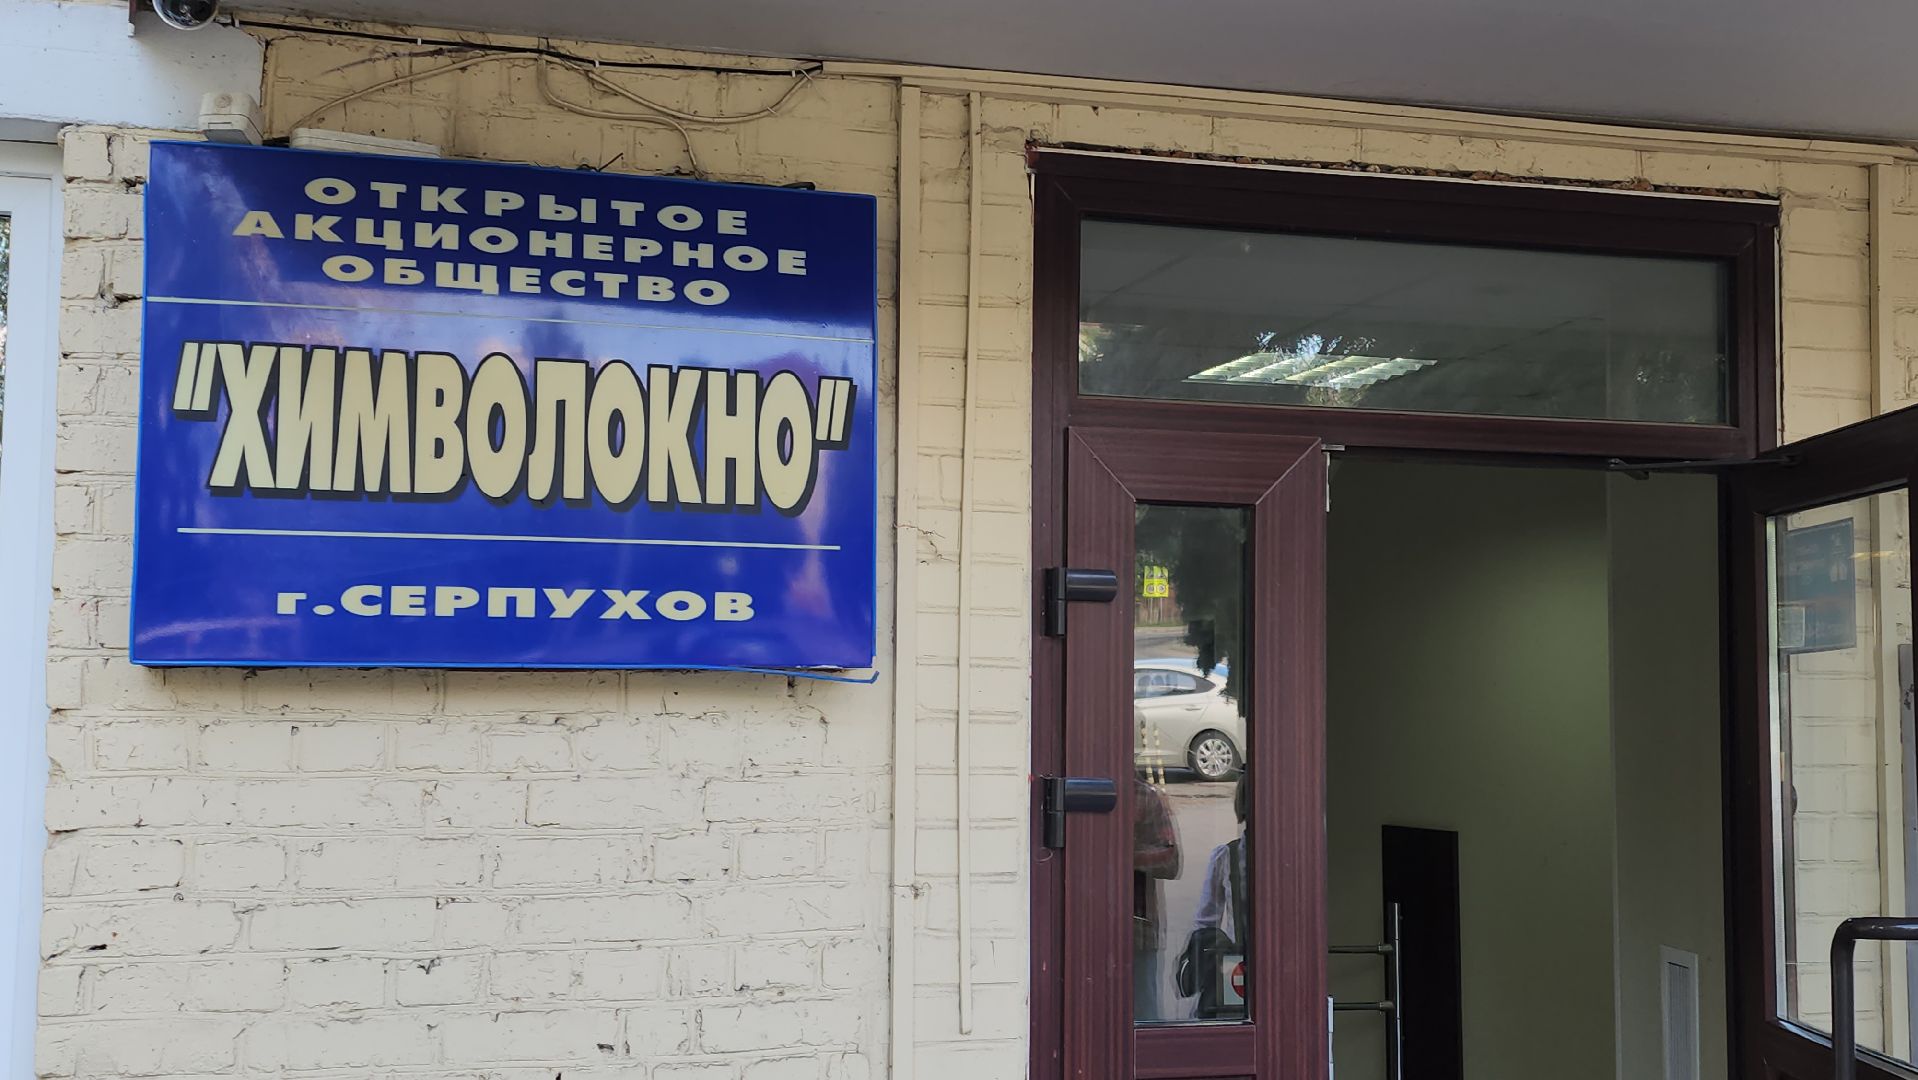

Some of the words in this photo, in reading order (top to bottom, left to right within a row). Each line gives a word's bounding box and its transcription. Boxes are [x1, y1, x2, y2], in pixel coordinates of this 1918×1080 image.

[304, 177, 748, 236] ОТКРЫТОЕ
[232, 210, 808, 276] АКЦИОНЕРНОЕ
[322, 255, 731, 306] ОБЩЕСТВО
[173, 342, 853, 511] "ХИМВОЛОКНО"
